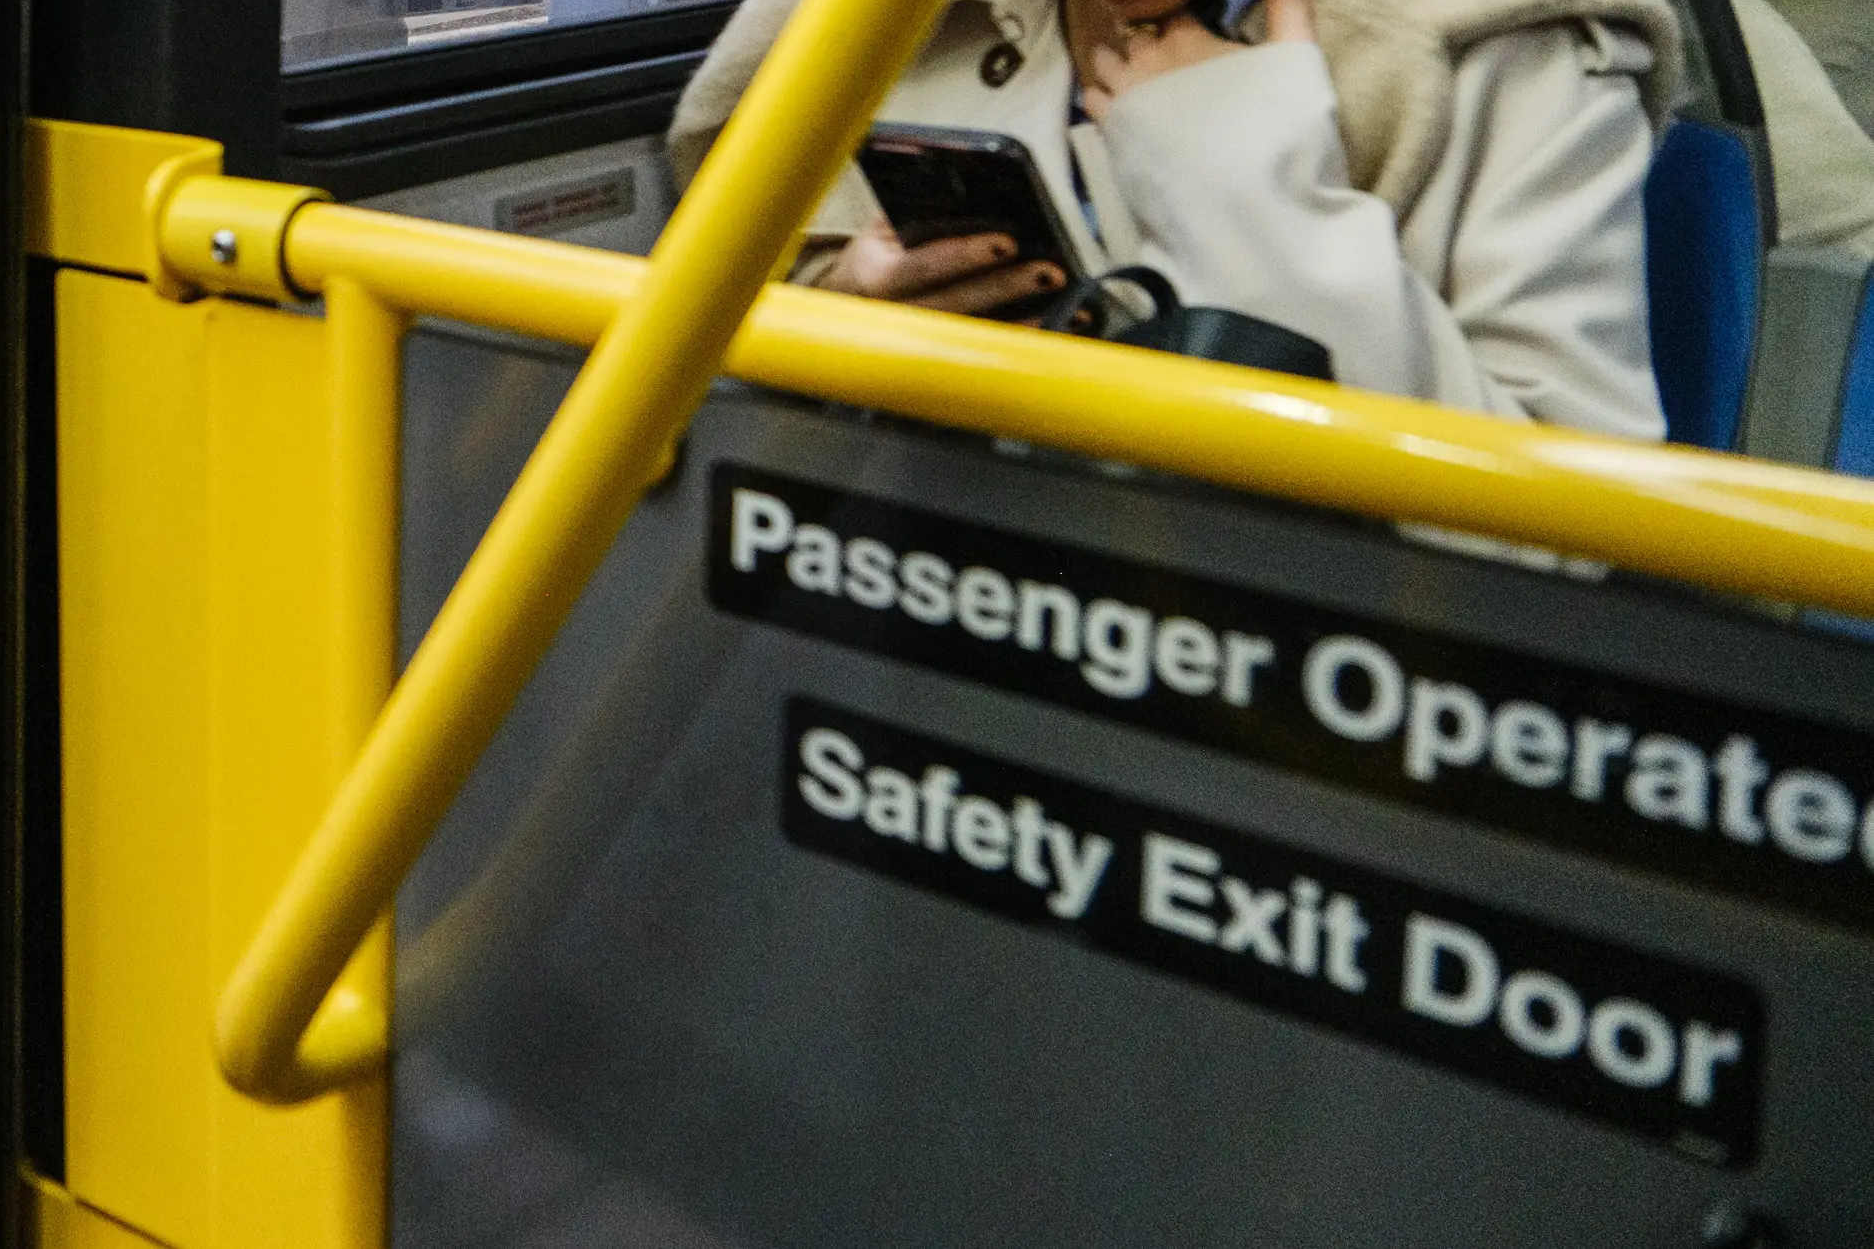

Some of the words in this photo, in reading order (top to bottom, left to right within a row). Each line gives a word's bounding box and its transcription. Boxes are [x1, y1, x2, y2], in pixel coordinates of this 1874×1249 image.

[728, 486, 1275, 708] Passenger
[1301, 635, 1874, 872] Operate
[796, 722, 1113, 921] Safety
[1139, 830, 1372, 996] Exit
[1401, 910, 1742, 1108] Door
